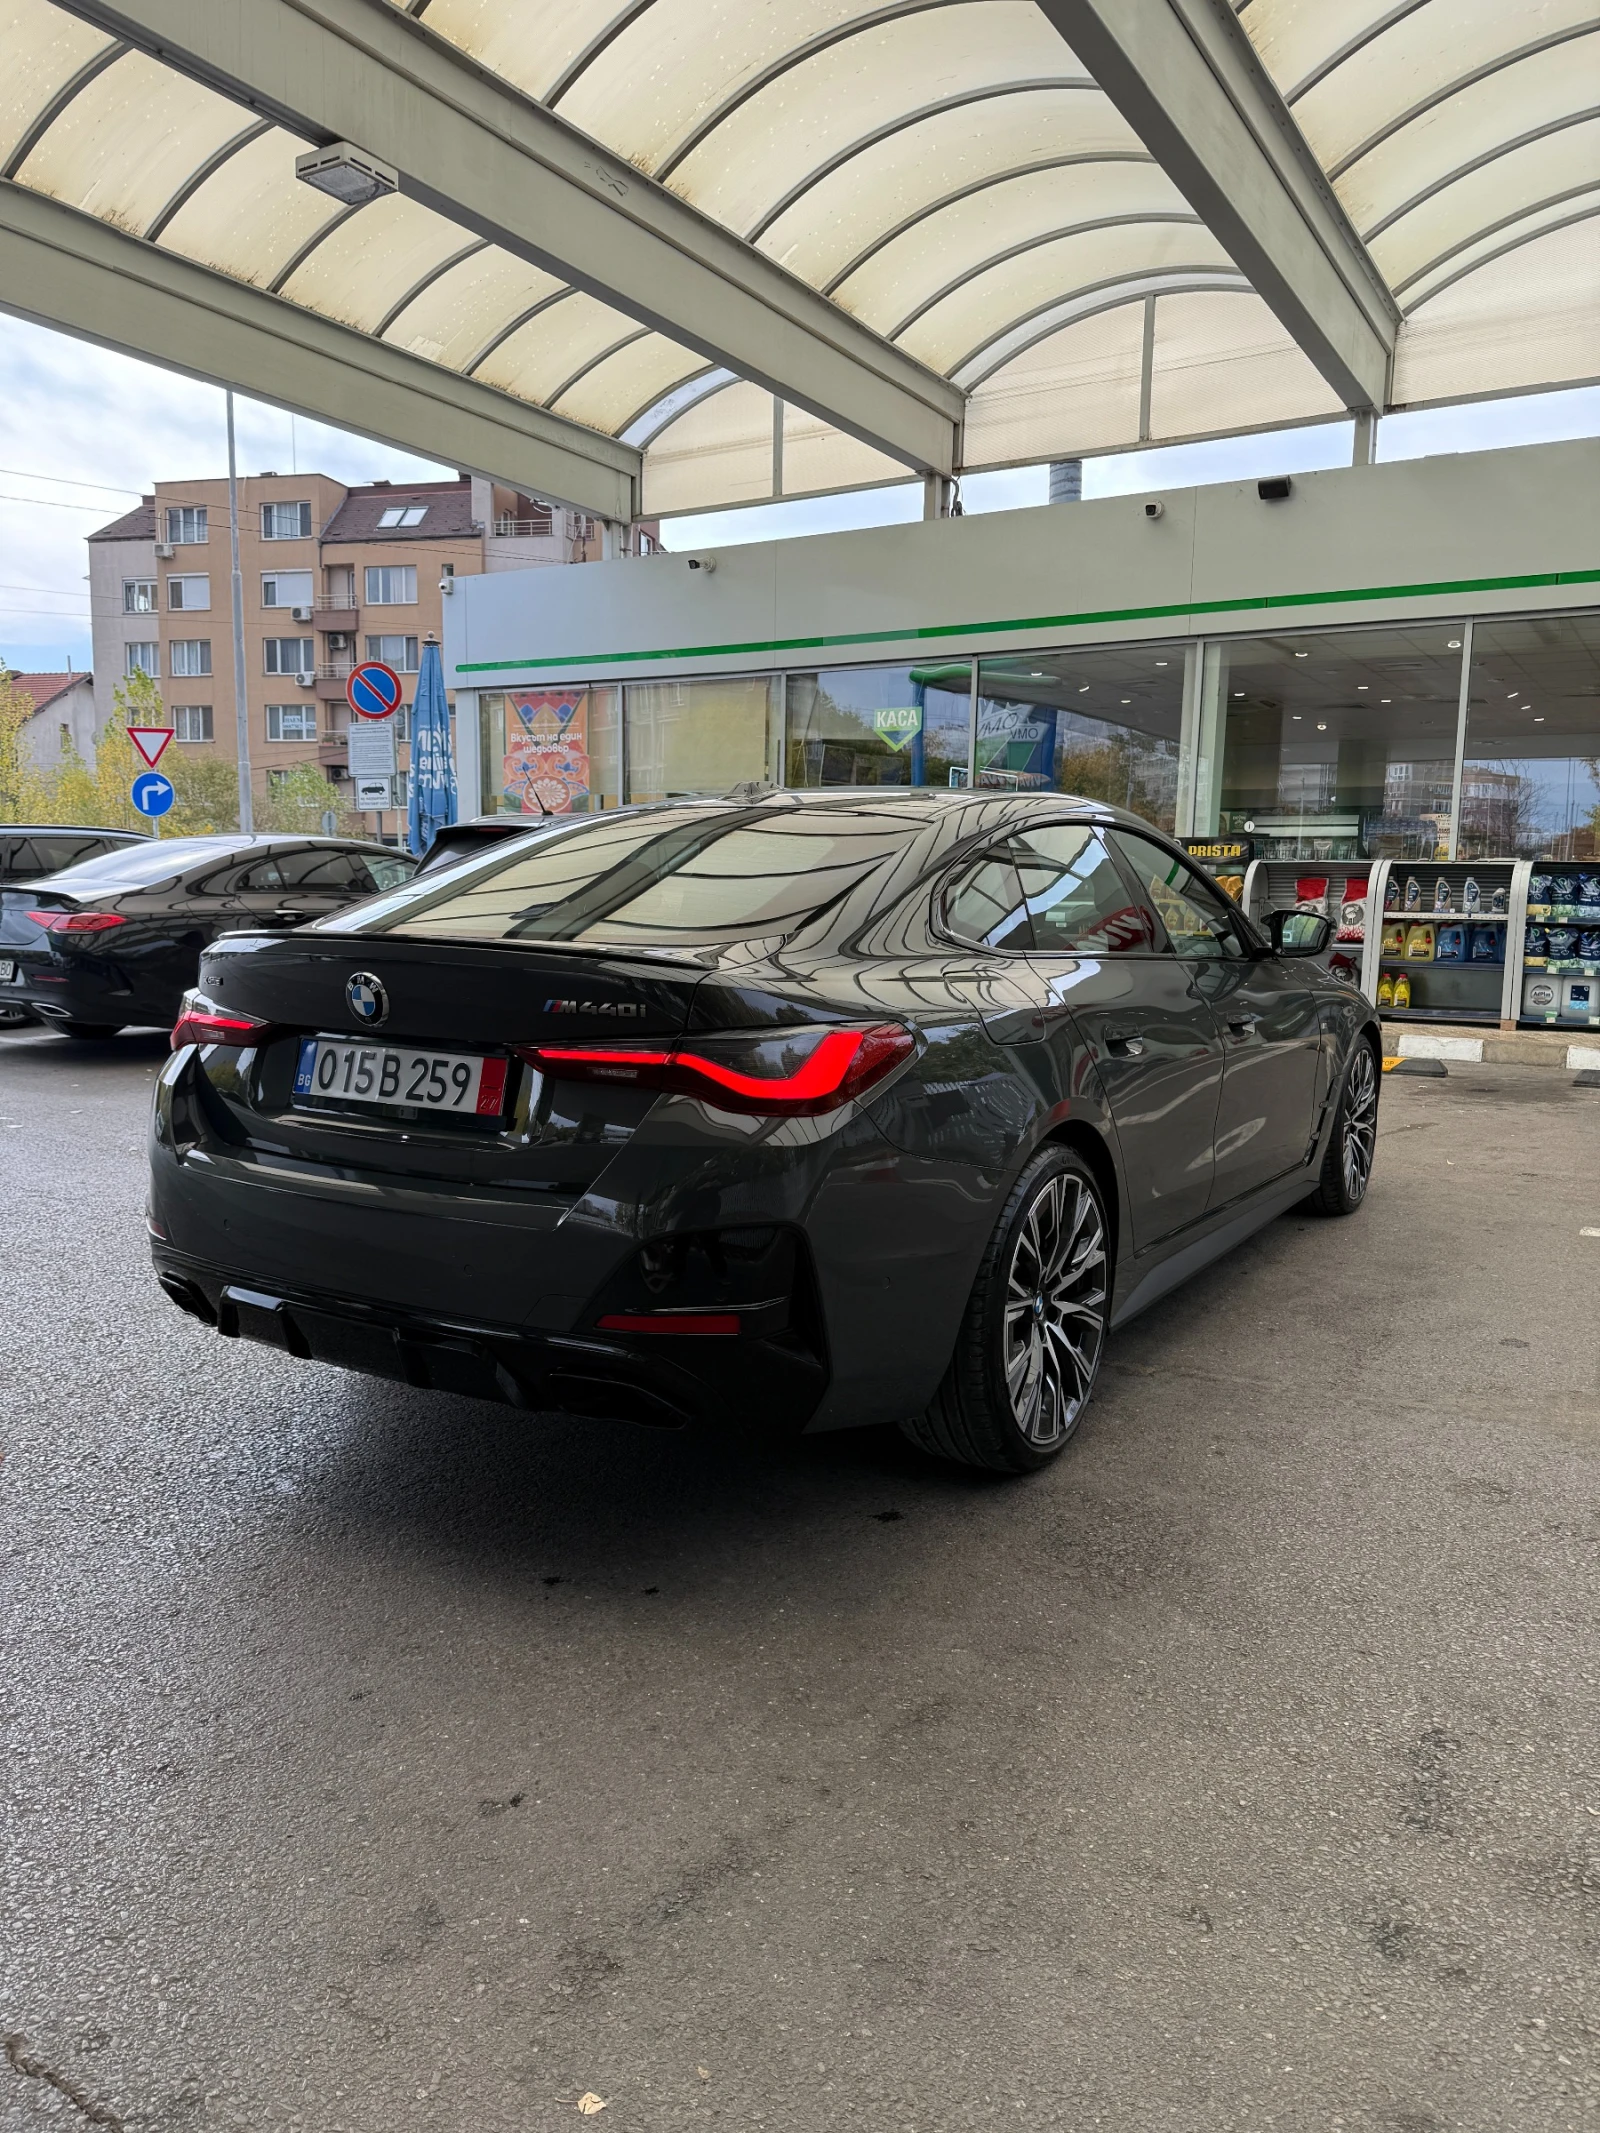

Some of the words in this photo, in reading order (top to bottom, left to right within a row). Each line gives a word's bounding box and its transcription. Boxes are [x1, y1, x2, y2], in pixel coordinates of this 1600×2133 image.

[876, 709, 918, 728] КАСА
[510, 733, 546, 744] Вкусът
[547, 733, 559, 741] на
[559, 732, 582, 743] един
[523, 743, 570, 755] шедьовър
[1187, 845, 1241, 857] PRISTA
[347, 975, 379, 993] BMW
[559, 1000, 646, 1017] M440i
[297, 1073, 311, 1087] BG
